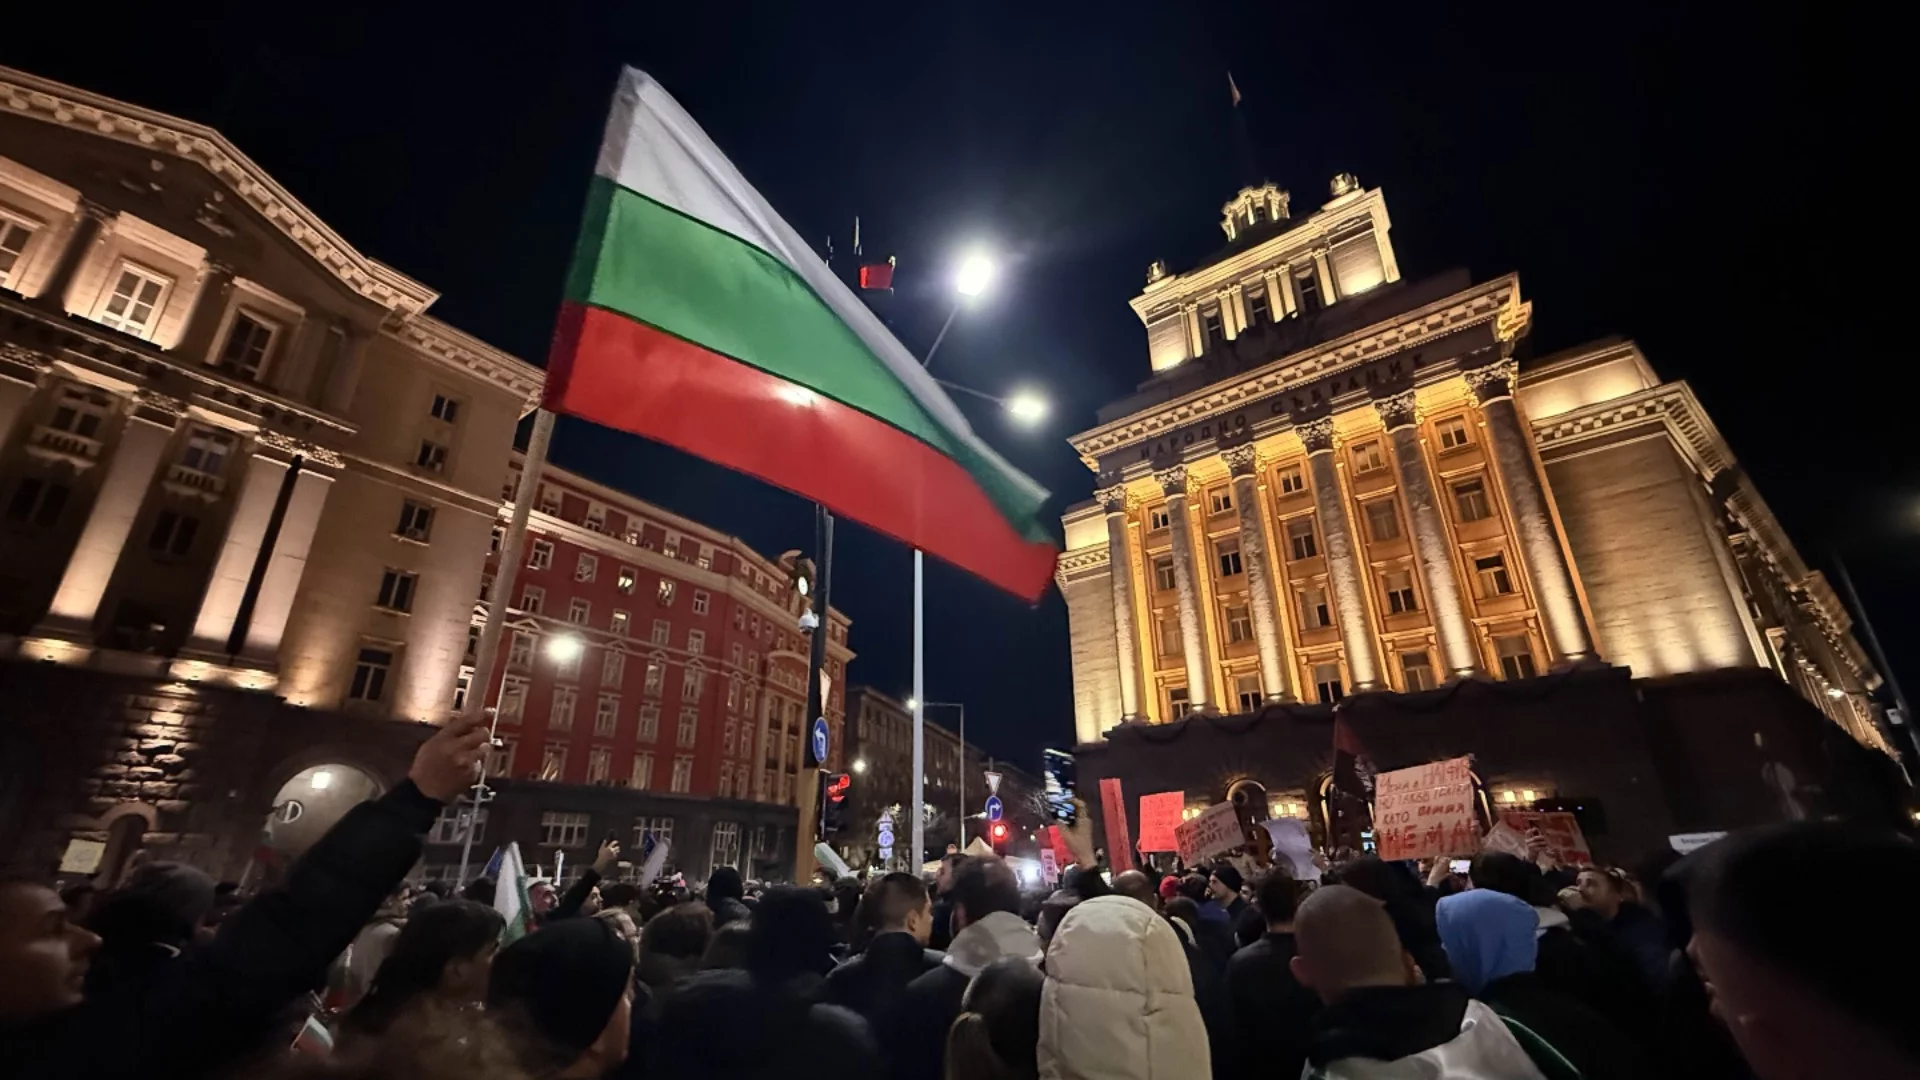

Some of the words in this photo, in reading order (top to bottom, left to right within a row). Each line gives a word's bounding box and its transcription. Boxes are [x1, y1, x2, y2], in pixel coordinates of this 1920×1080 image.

[1140, 414, 1247, 458] НАРОДНО
[1270, 352, 1428, 415] СЪБРАНИЕ
[1382, 811, 1410, 825] КАТО
